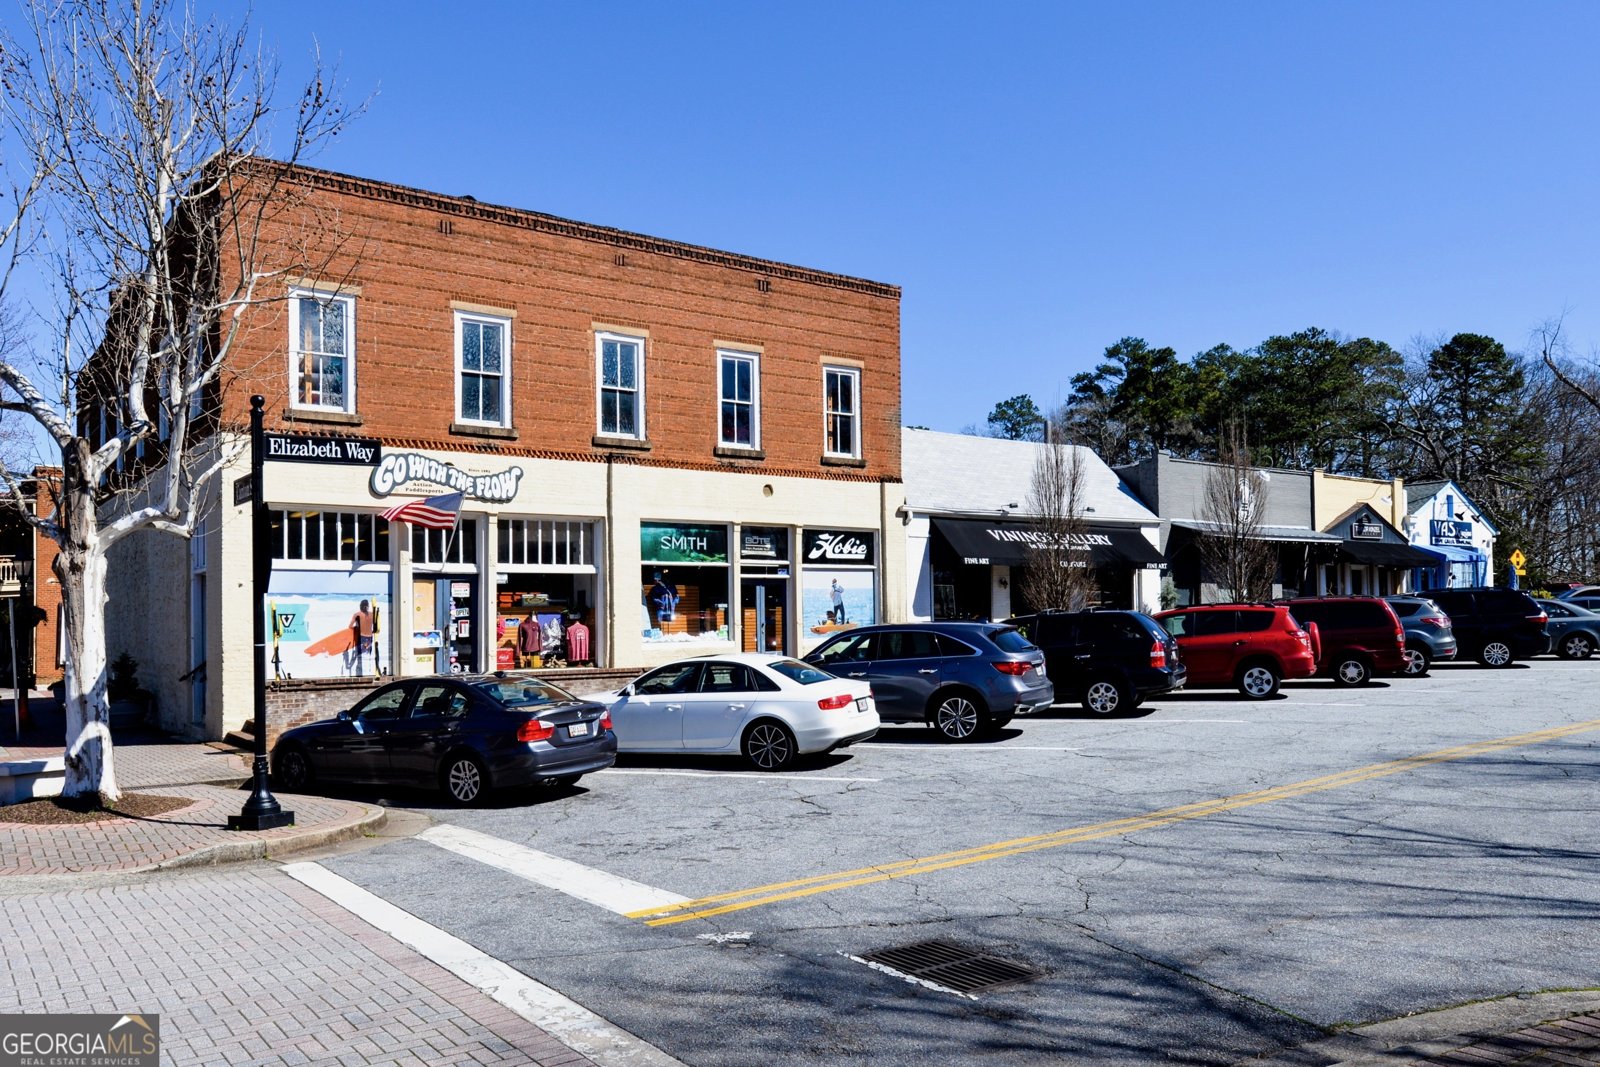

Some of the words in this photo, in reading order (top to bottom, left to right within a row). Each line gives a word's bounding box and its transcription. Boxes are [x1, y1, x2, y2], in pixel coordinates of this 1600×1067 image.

[268, 437, 342, 458] Elizabeth
[345, 441, 375, 463] Way
[374, 454, 407, 493] GO
[407, 454, 448, 483] WITH
[449, 467, 476, 493] THE
[475, 466, 523, 499] FLOW
[1433, 520, 1456, 537] VAS
[660, 535, 708, 551] SMITH
[808, 532, 868, 560] Hobie
[985, 529, 1055, 544] VININGS
[1054, 532, 1114, 547] GALLERY
[964, 557, 979, 565] FINE
[978, 557, 990, 565] ART
[1146, 562, 1158, 570] FINE
[1158, 562, 1168, 570] ART
